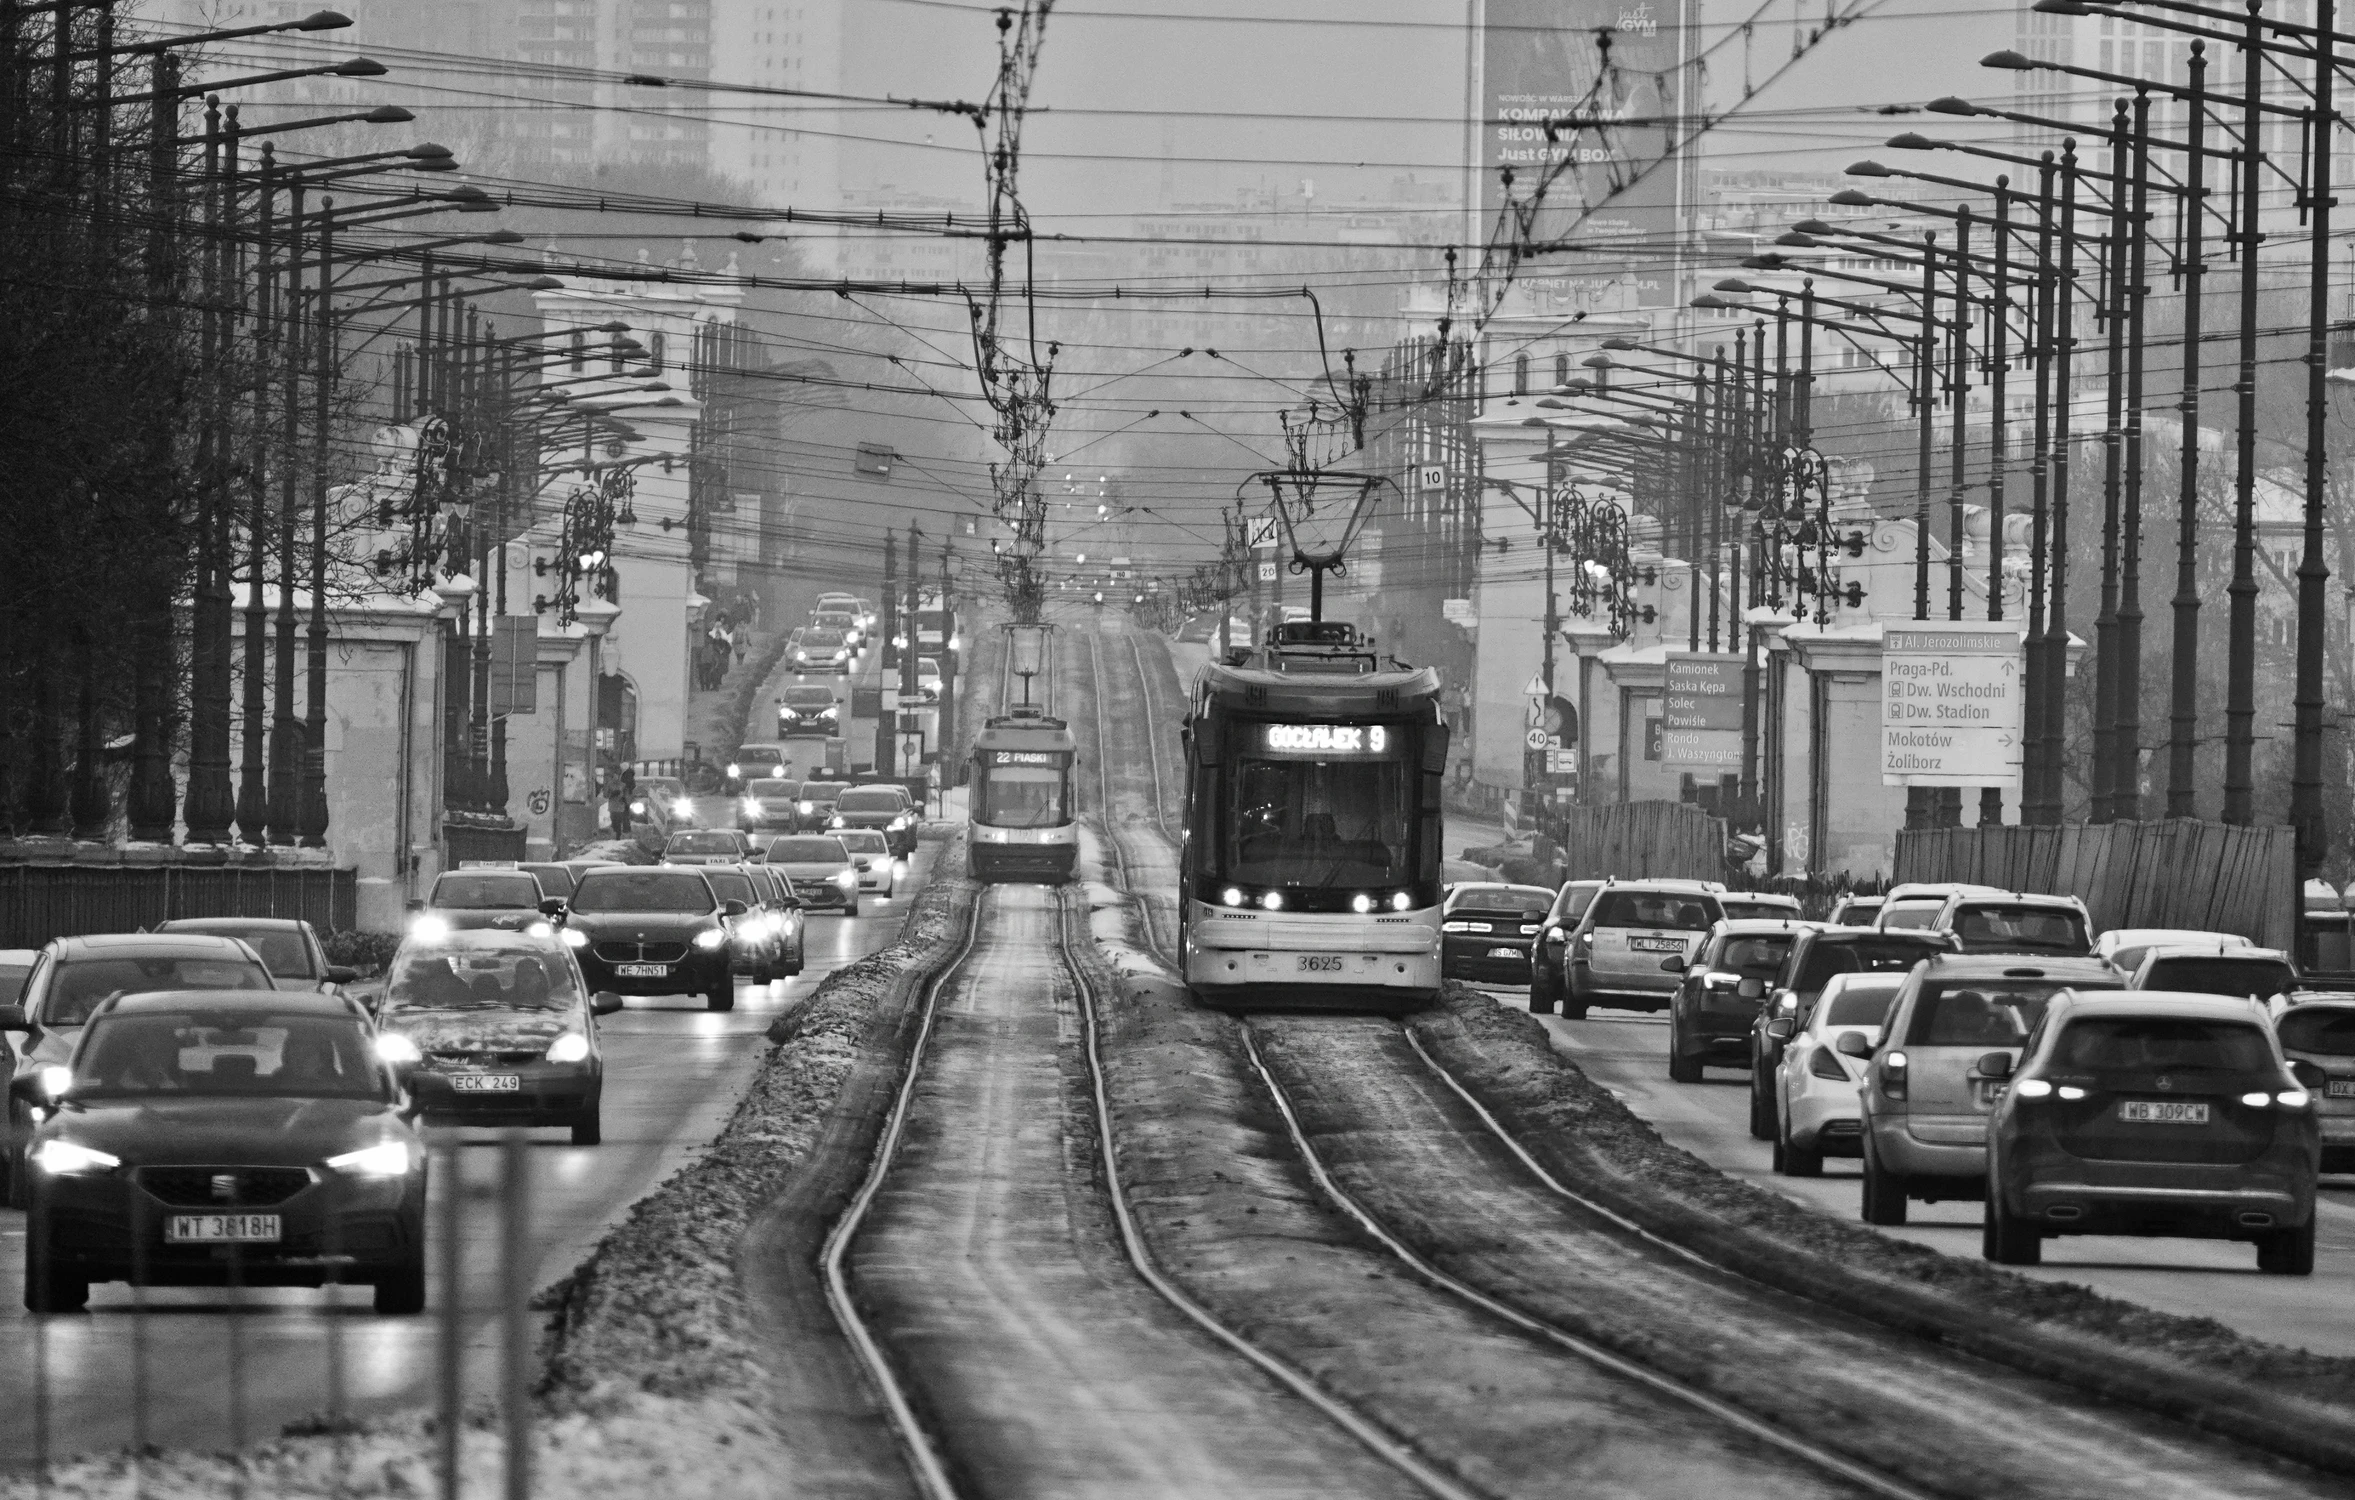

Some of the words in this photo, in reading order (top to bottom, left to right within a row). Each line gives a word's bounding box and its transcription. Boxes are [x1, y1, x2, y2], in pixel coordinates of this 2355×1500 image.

[1622, 20, 1656, 31] GYM
[1498, 147, 1535, 161] Just
[1425, 471, 1440, 484] 10
[1262, 567, 1275, 577] 20
[1905, 635, 1920, 648] Al.
[1923, 635, 2001, 648] Jerozolimskie
[1669, 662, 1719, 675] Kamionek
[1890, 661, 1953, 679] Praga-Pd.
[1669, 680, 1698, 692] Saska
[1700, 680, 1726, 695] Kępa
[1907, 683, 1932, 698] Dw.
[1937, 682, 2005, 698] Wschodni
[1668, 697, 1695, 709] Solec
[1906, 704, 1932, 719] Dw.
[1936, 703, 1990, 719] Stadion
[1668, 714, 1706, 727] Powiśle
[1370, 725, 1385, 752] 9
[1529, 732, 1545, 744] 40
[1667, 732, 1699, 744] Rondo
[1888, 731, 1952, 747] Mokotów
[997, 752, 1010, 763] 22
[1014, 753, 1047, 763] PIASKI
[1667, 747, 1675, 759] J.
[1677, 747, 1743, 762] Waszyngton
[1887, 751, 1941, 769] Żoliborz
[620, 965, 632, 975] WE
[1298, 956, 1342, 971] 3625
[455, 1077, 483, 1089] ECK
[492, 1077, 517, 1089] 249
[2129, 1103, 2148, 1119] WB
[179, 1217, 202, 1237] WT
